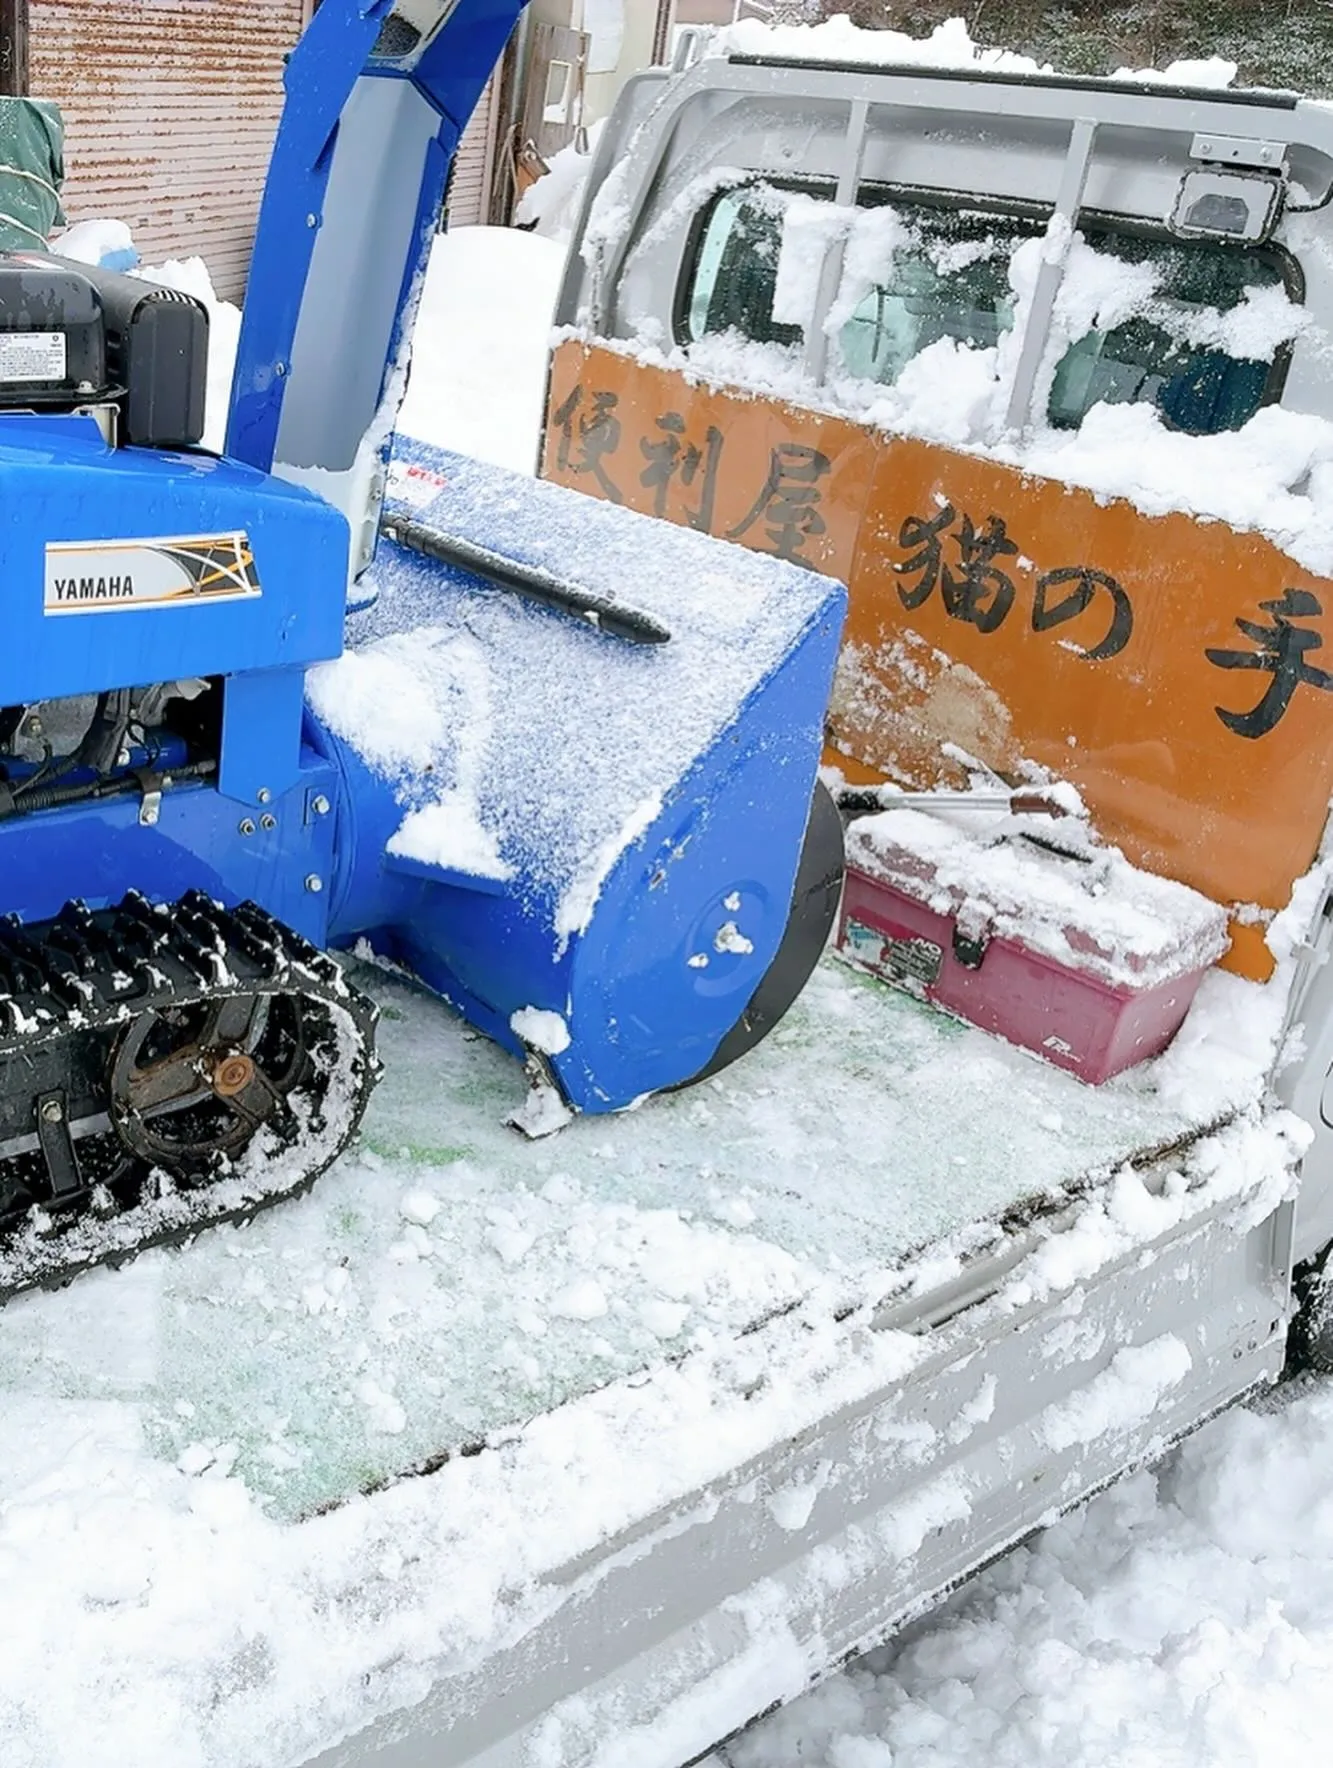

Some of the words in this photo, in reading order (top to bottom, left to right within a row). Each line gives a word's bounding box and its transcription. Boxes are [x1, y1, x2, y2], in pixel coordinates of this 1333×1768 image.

[553, 384, 831, 572] 便利屋
[55, 576, 133, 600] YAMAHA
